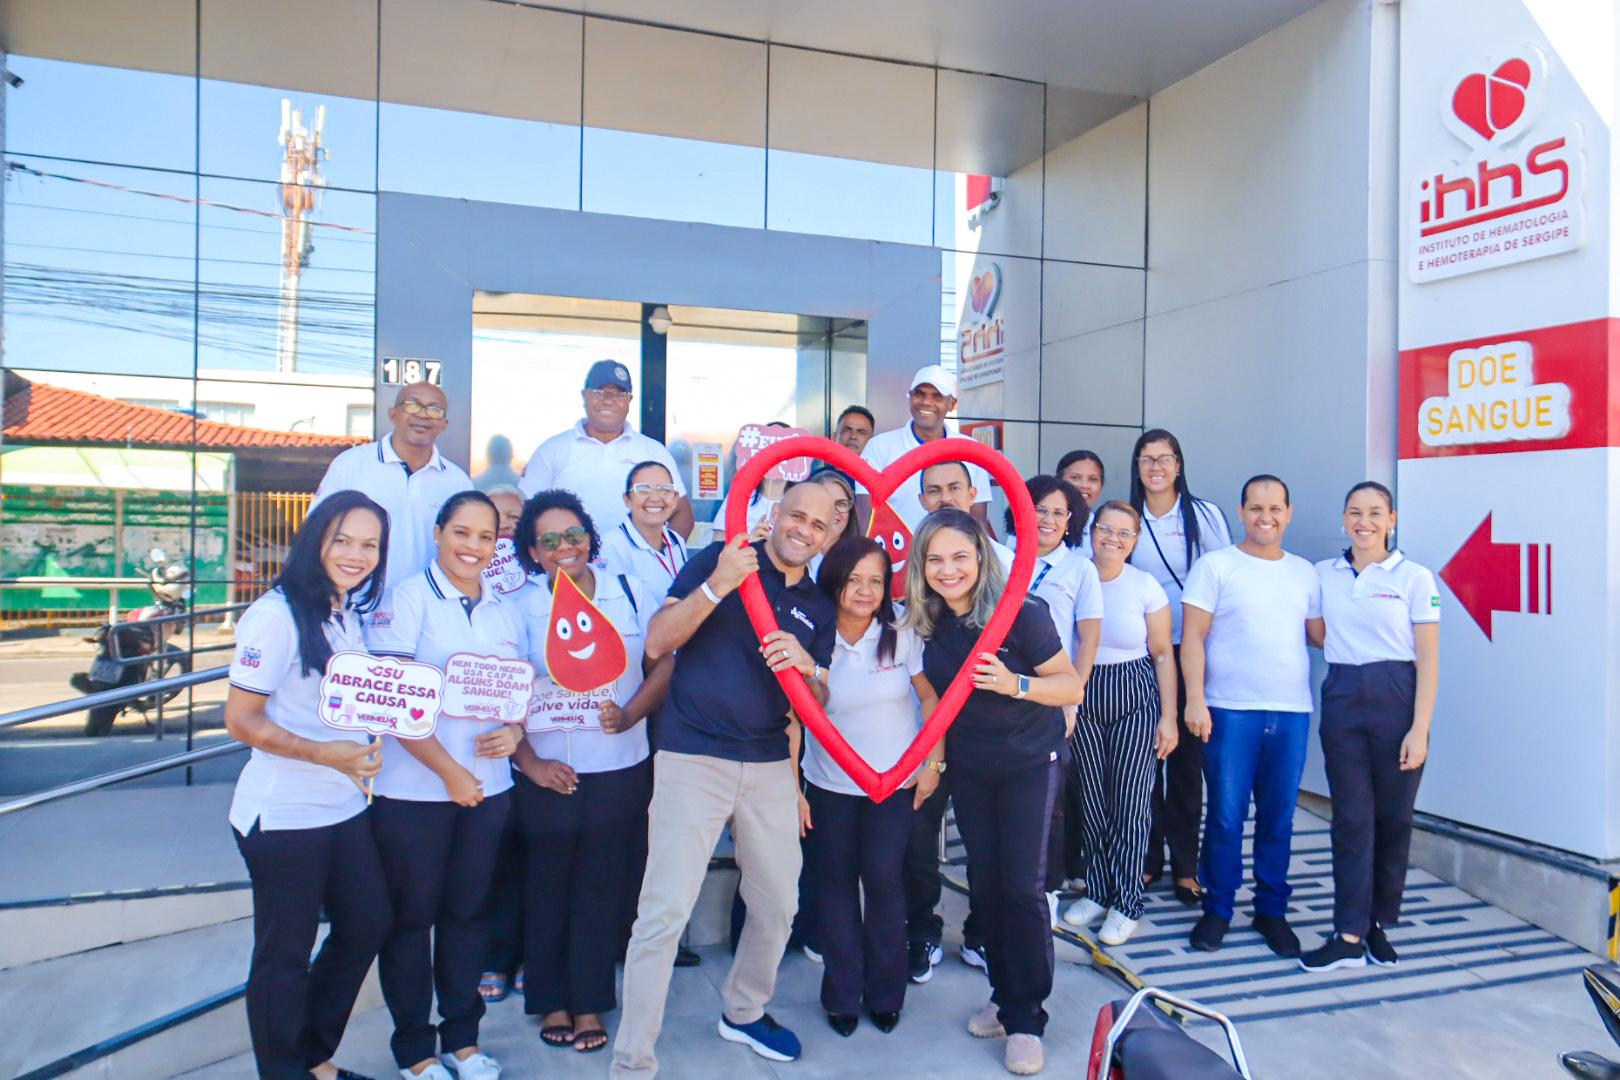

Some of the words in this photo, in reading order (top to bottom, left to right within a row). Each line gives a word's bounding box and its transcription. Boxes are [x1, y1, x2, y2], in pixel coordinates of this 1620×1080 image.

[1419, 235, 1470, 254] INSTITUTO
[1473, 230, 1485, 242] DE
[1489, 210, 1568, 237] HEMATOLOGIA
[1418, 260, 1424, 270] E
[1427, 244, 1501, 269] HEMOTERAPIA
[1504, 239, 1518, 251] DE
[1522, 226, 1569, 247] SERGIPE
[384, 359, 440, 385] 187
[1458, 353, 1517, 389] DOE
[1427, 395, 1552, 436] SANGUE
[367, 666, 404, 679] GSU
[452, 660, 471, 668] NEM
[474, 663, 497, 671] TODO
[448, 675, 493, 687] ALGUNS
[496, 680, 529, 691] DOAM
[463, 669, 483, 677] USA
[487, 671, 513, 680] CAPA
[330, 673, 393, 692] ABRACE
[397, 683, 436, 699] ESSA
[462, 686, 512, 698] SANGUE!
[356, 692, 407, 709] CAUSA
[569, 699, 599, 710] vida
